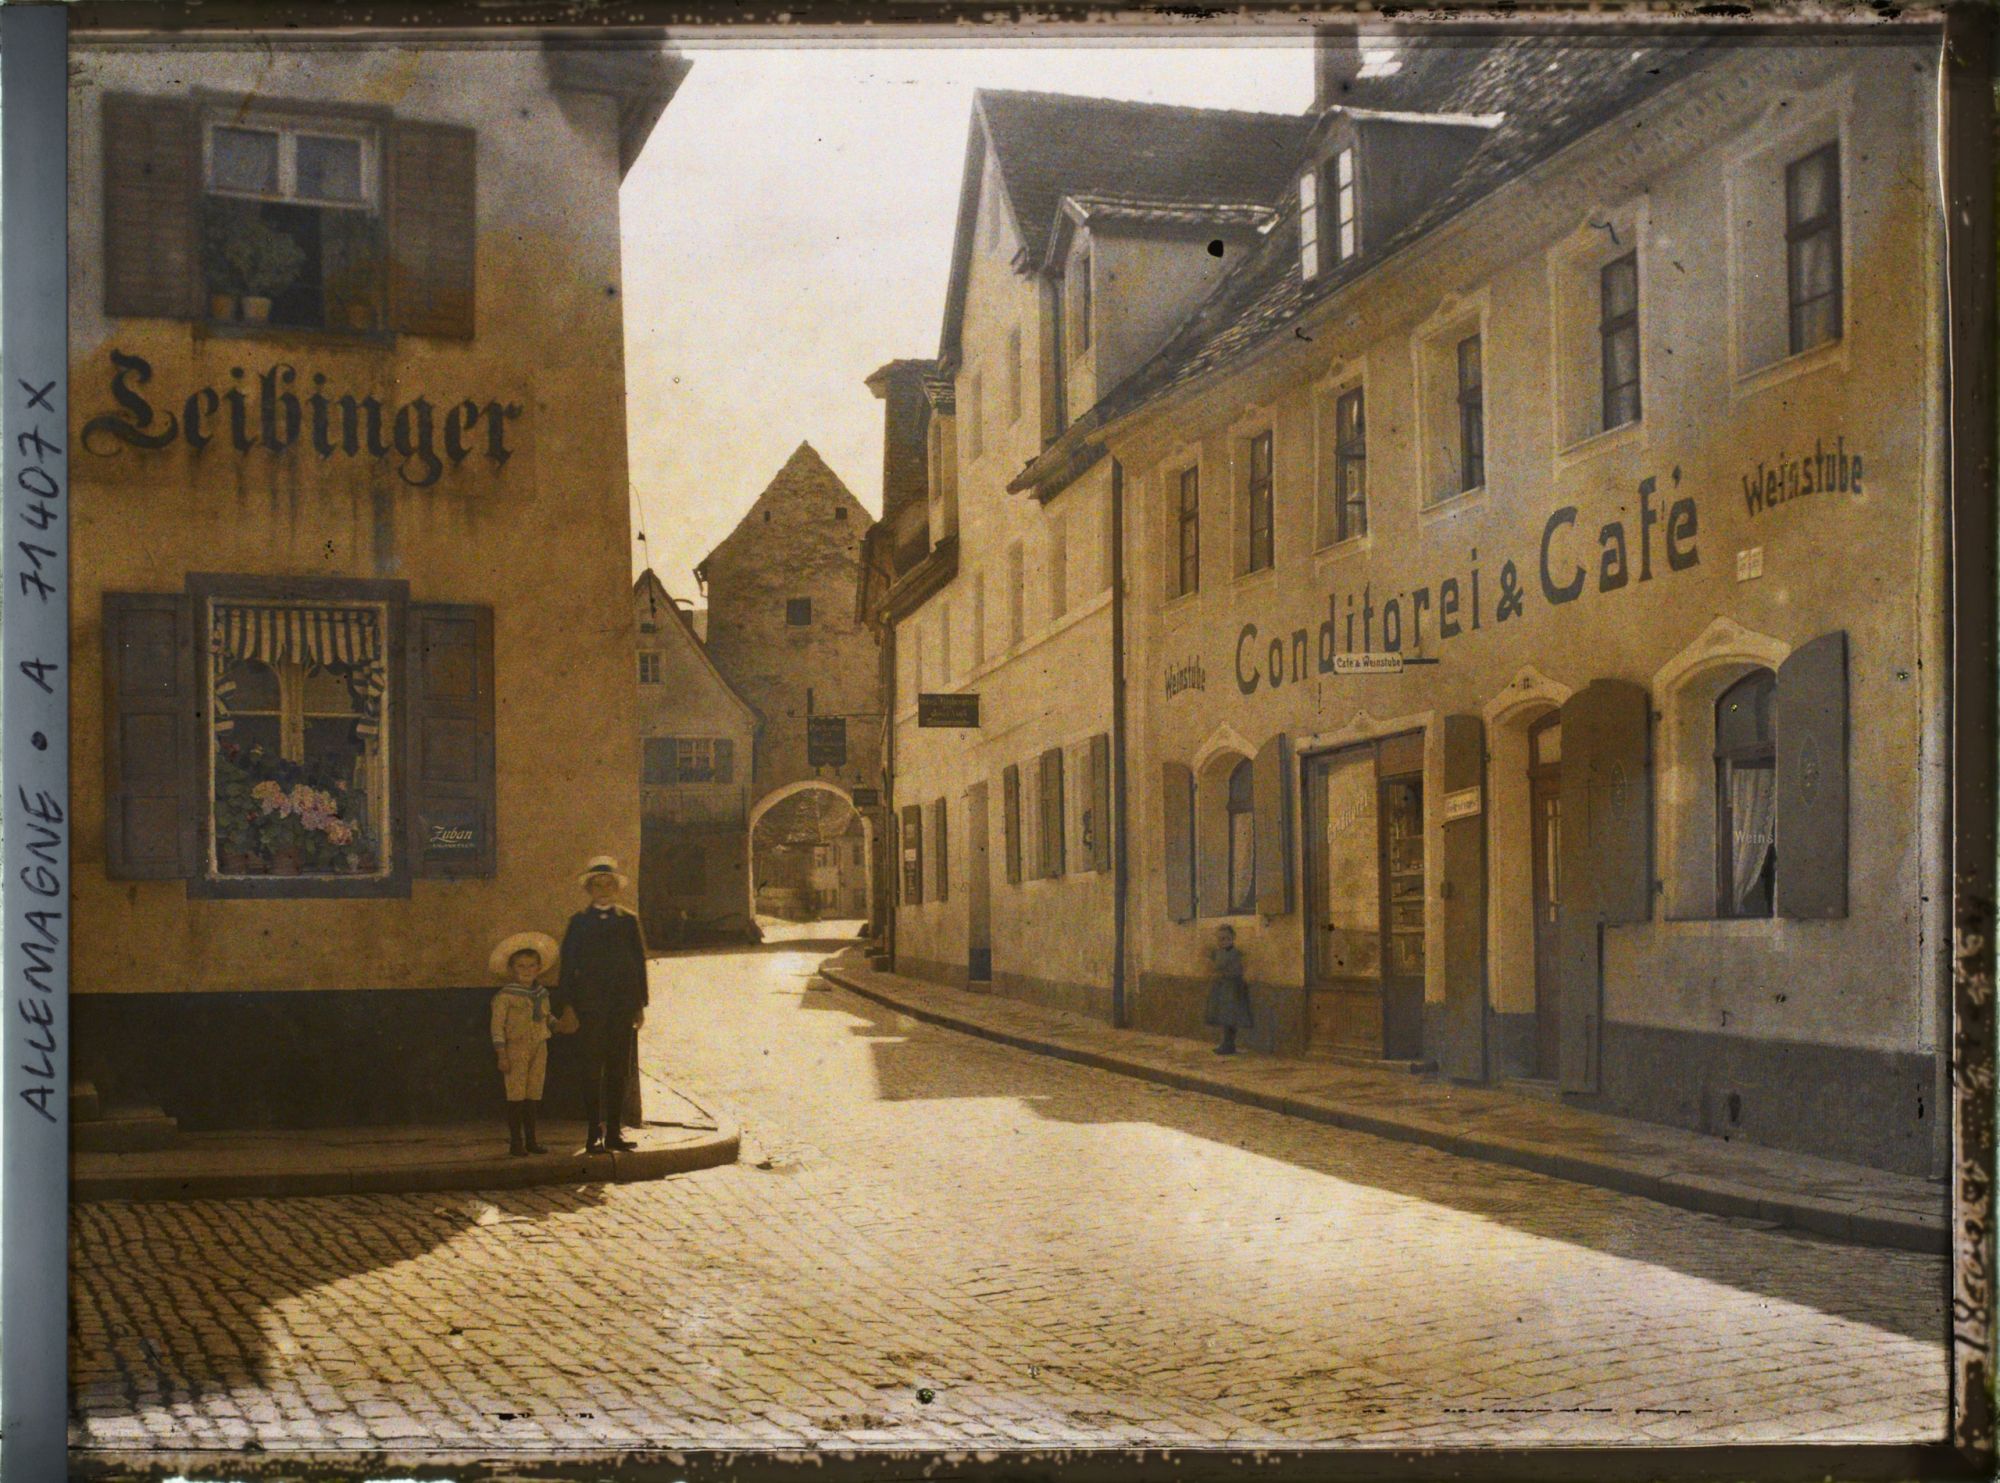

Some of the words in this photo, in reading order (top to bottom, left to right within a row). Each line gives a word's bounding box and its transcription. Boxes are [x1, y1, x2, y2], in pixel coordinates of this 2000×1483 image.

[80, 347, 525, 488] Leibinger
[1741, 435, 1864, 517] Weinstube
[1234, 547, 1481, 696] Conditorei
[1496, 558, 1525, 624] &
[1539, 464, 1701, 607] Café
[19, 657, 59, 695] A
[1163, 654, 1206, 702] Weinstube
[18, 784, 64, 1124] ALLEMAGNE
